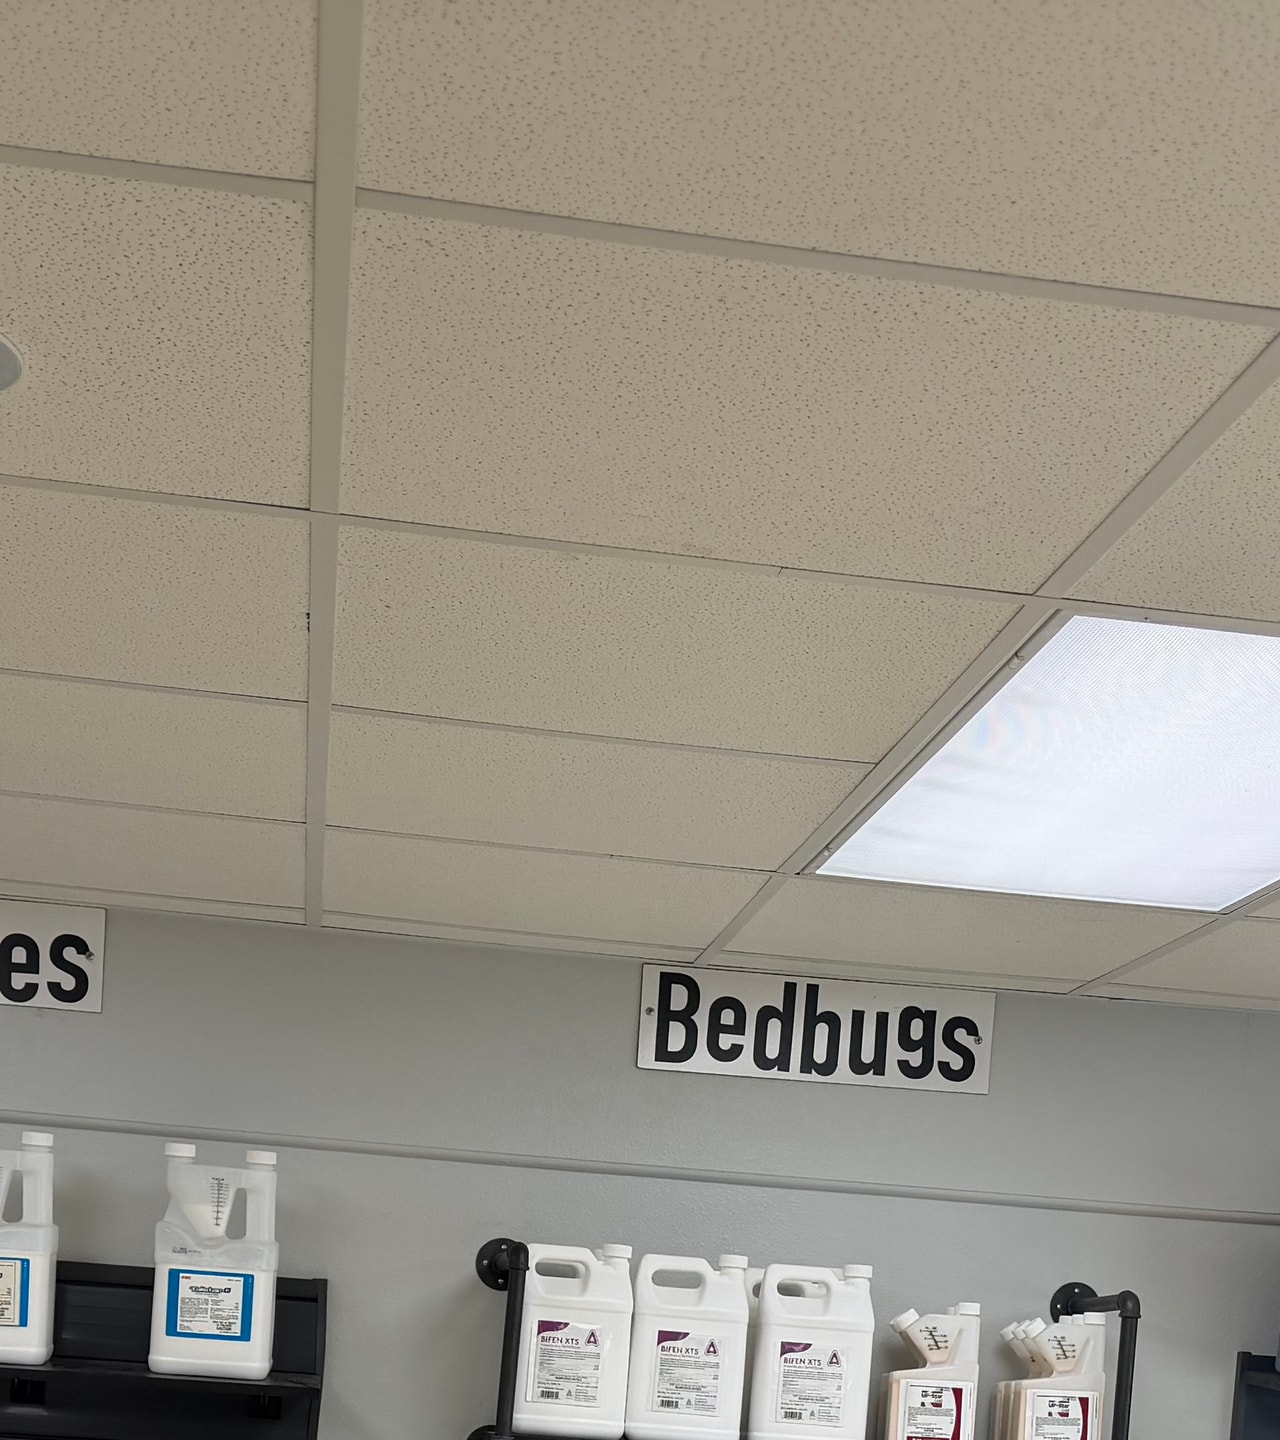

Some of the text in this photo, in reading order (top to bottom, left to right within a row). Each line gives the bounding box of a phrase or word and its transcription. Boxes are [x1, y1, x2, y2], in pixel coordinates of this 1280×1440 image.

[654, 971, 979, 1082] Bedbugs
[540, 1335, 579, 1345] BIFEN XTS
[784, 1356, 806, 1366] BIFEN
